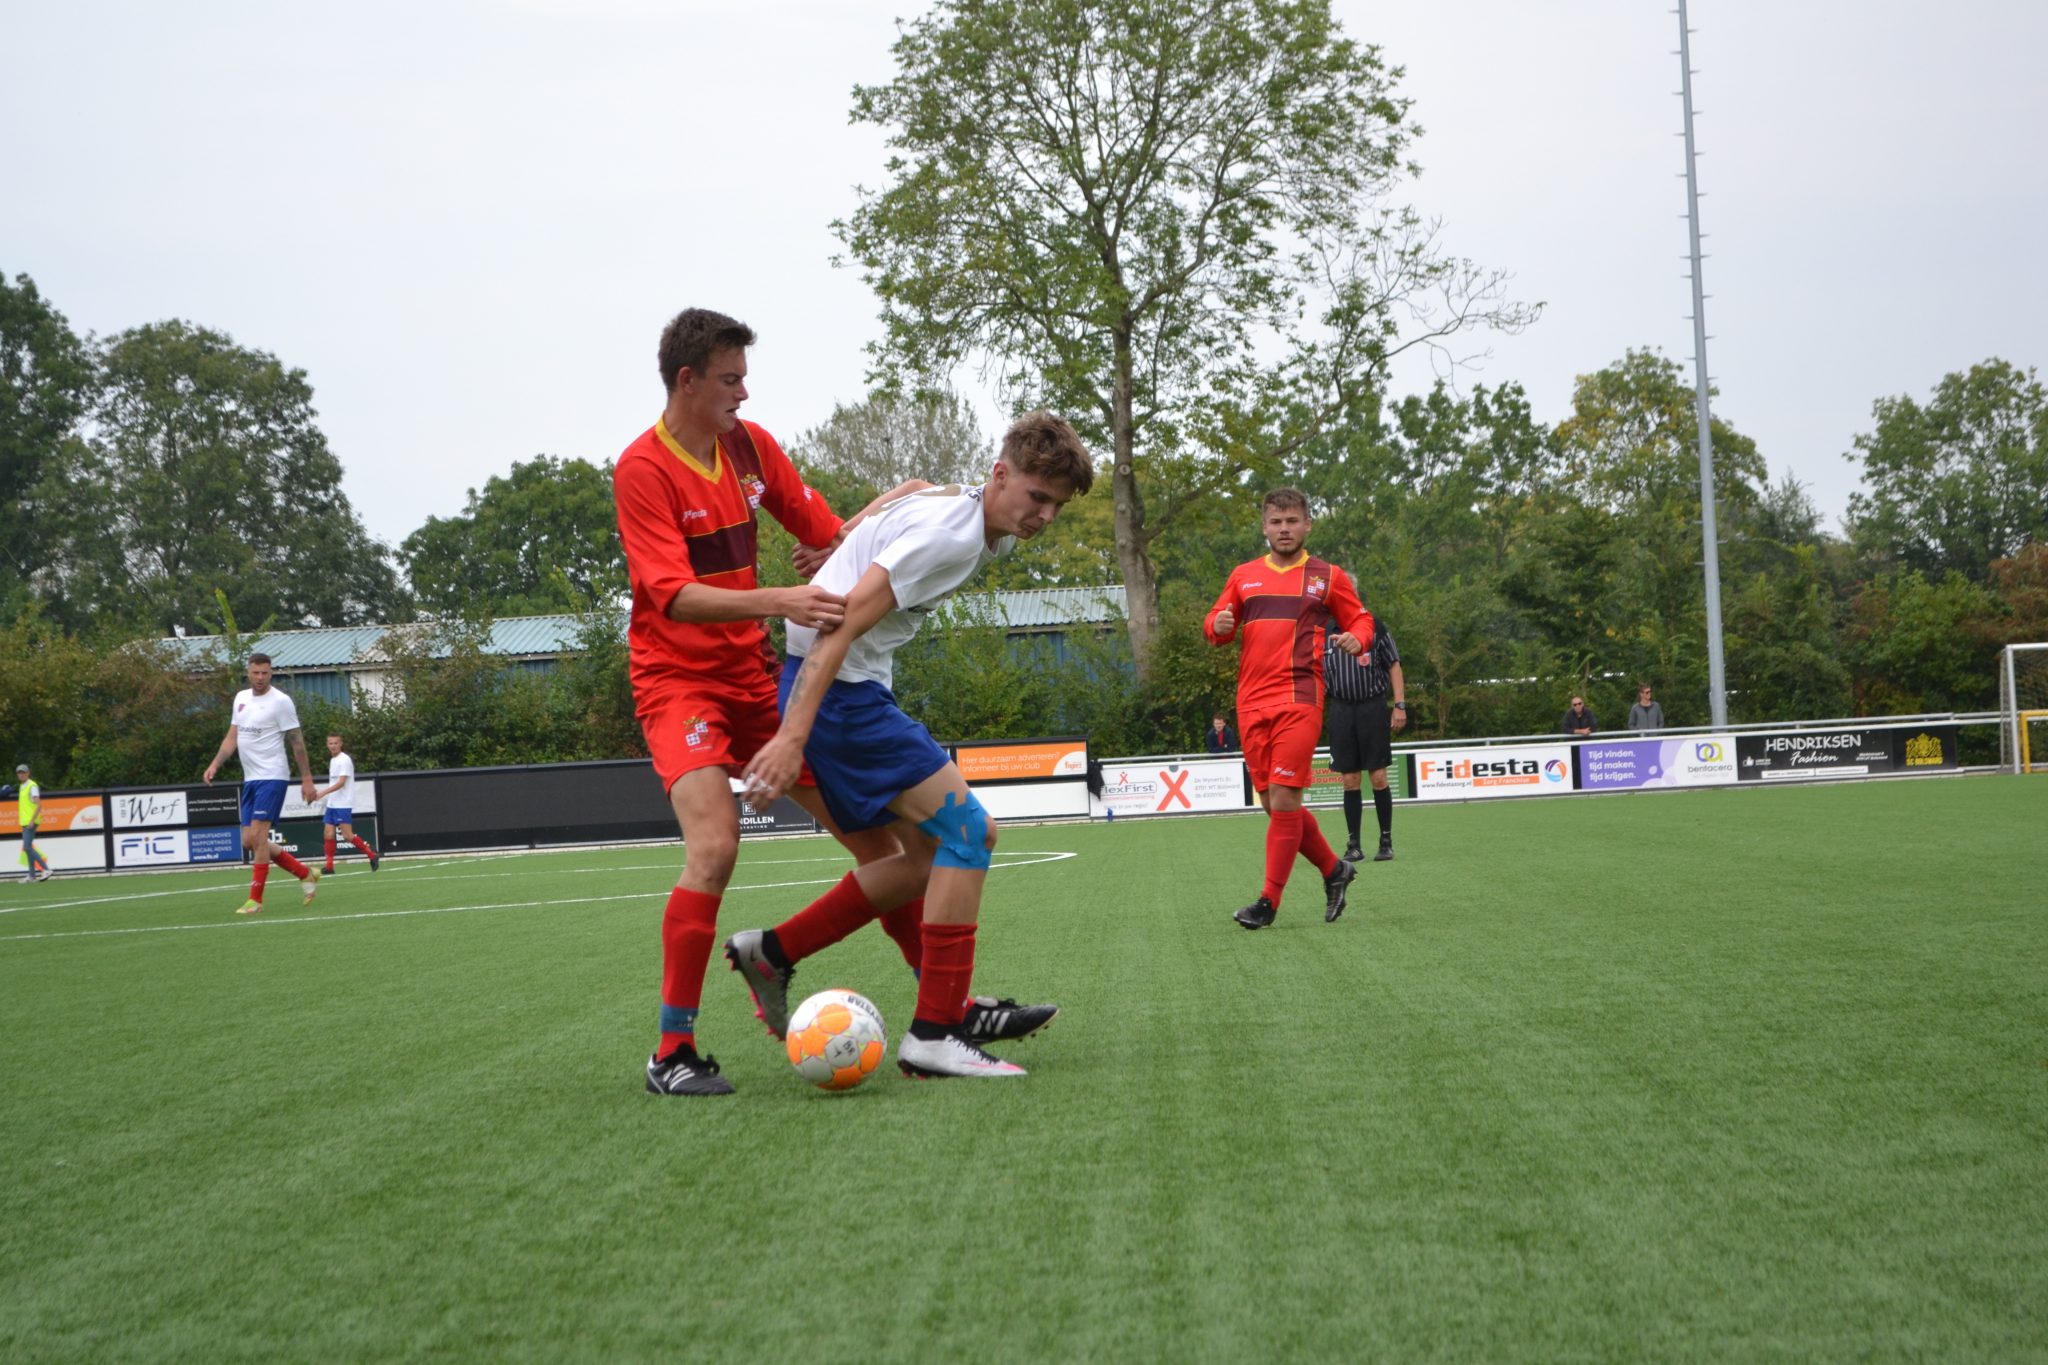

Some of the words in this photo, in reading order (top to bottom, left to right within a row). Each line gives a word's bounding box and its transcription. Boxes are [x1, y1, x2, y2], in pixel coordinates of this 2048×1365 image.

[1766, 734, 1861, 751] HENDRIKSEN
[979, 755, 1017, 763] duurzaam
[1790, 751, 1839, 766] Fashion
[1420, 759, 1539, 781] F-idesta
[1604, 761, 1636, 769] maken.
[1688, 763, 1733, 773] bentacera
[1604, 772, 1636, 782] krijgen.
[128, 796, 181, 824] Werf
